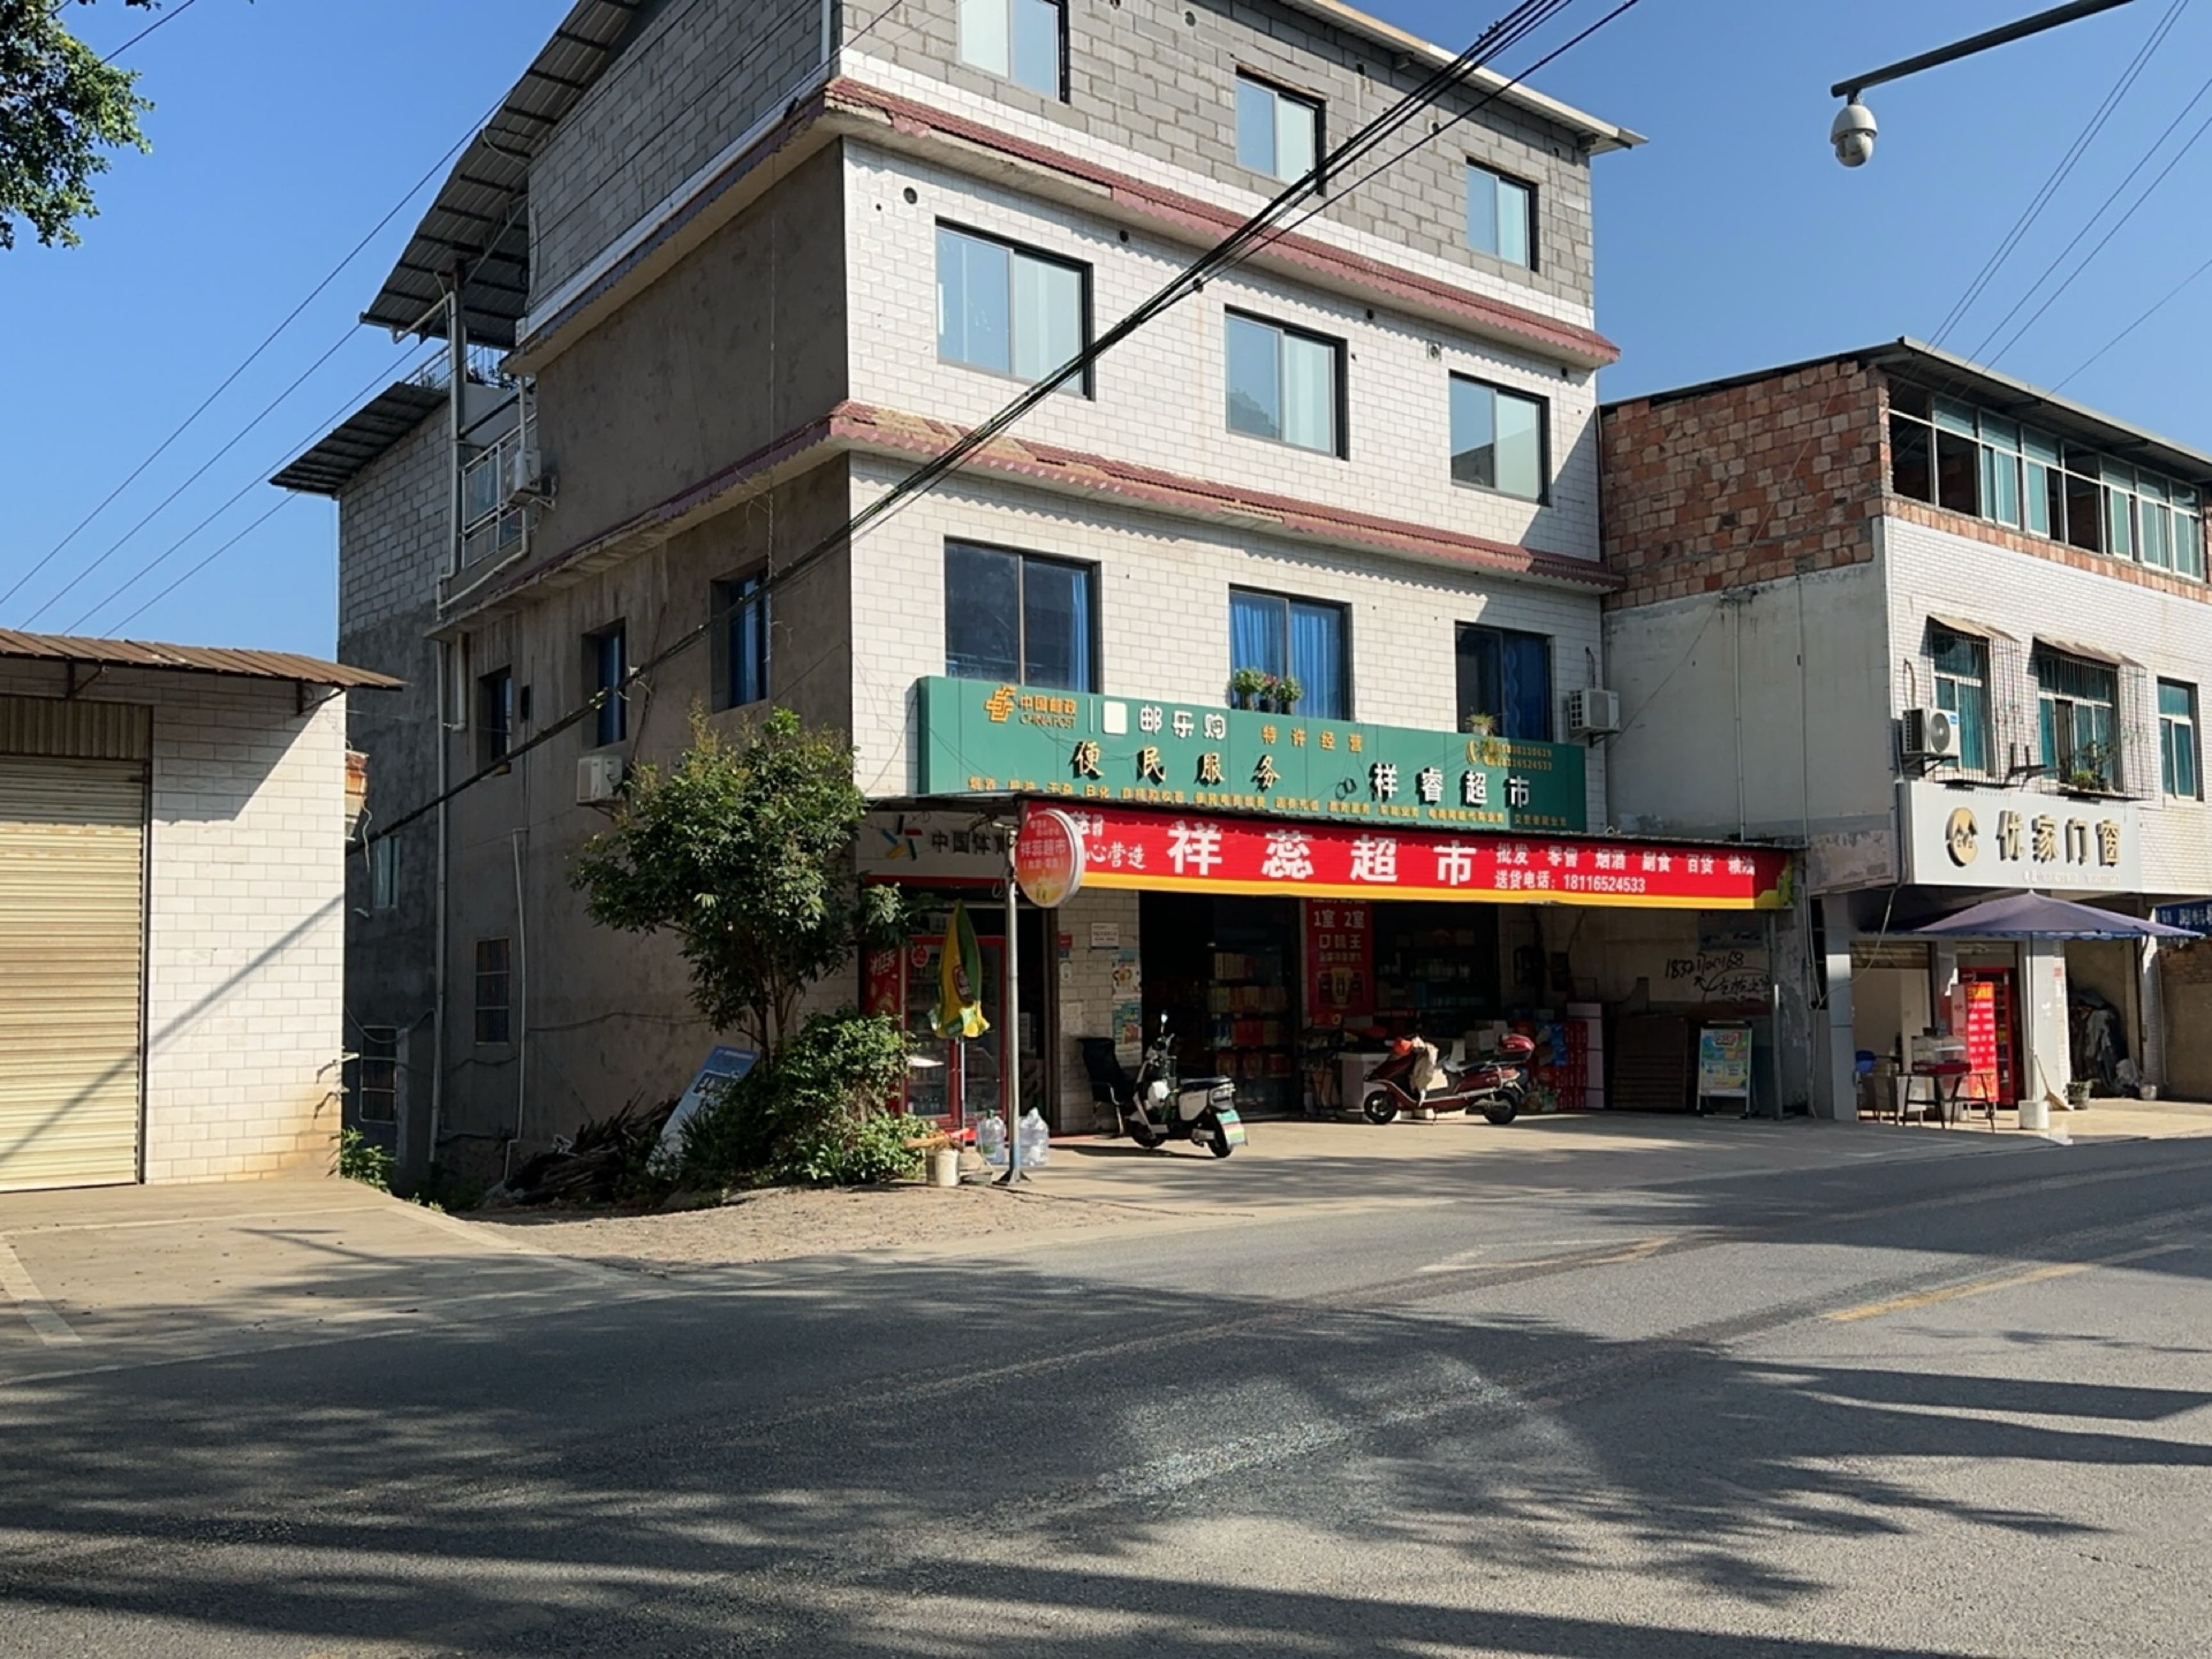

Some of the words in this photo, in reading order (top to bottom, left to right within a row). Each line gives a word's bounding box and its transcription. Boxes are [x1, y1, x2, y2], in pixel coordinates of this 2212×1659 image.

[1019, 694, 1077, 716] 中国邮政
[1020, 714, 1053, 726] CHINA
[1054, 717, 1076, 728] POST
[1139, 704, 1226, 739] 邮乐购
[1261, 725, 1363, 752] 特许经营
[1074, 740, 1281, 789] 便民服务
[1374, 763, 1530, 808] 祥睿超市
[1167, 820, 1477, 886] 祥蕊超市
[1998, 810, 2120, 866] 优家门窗
[1086, 842, 1146, 870] 心营造
[1496, 843, 1529, 866] 批发
[1548, 846, 1578, 869] 零售
[1595, 848, 1626, 870] 烟酒
[1642, 851, 1671, 873] 副食
[1687, 853, 1714, 875] 百货
